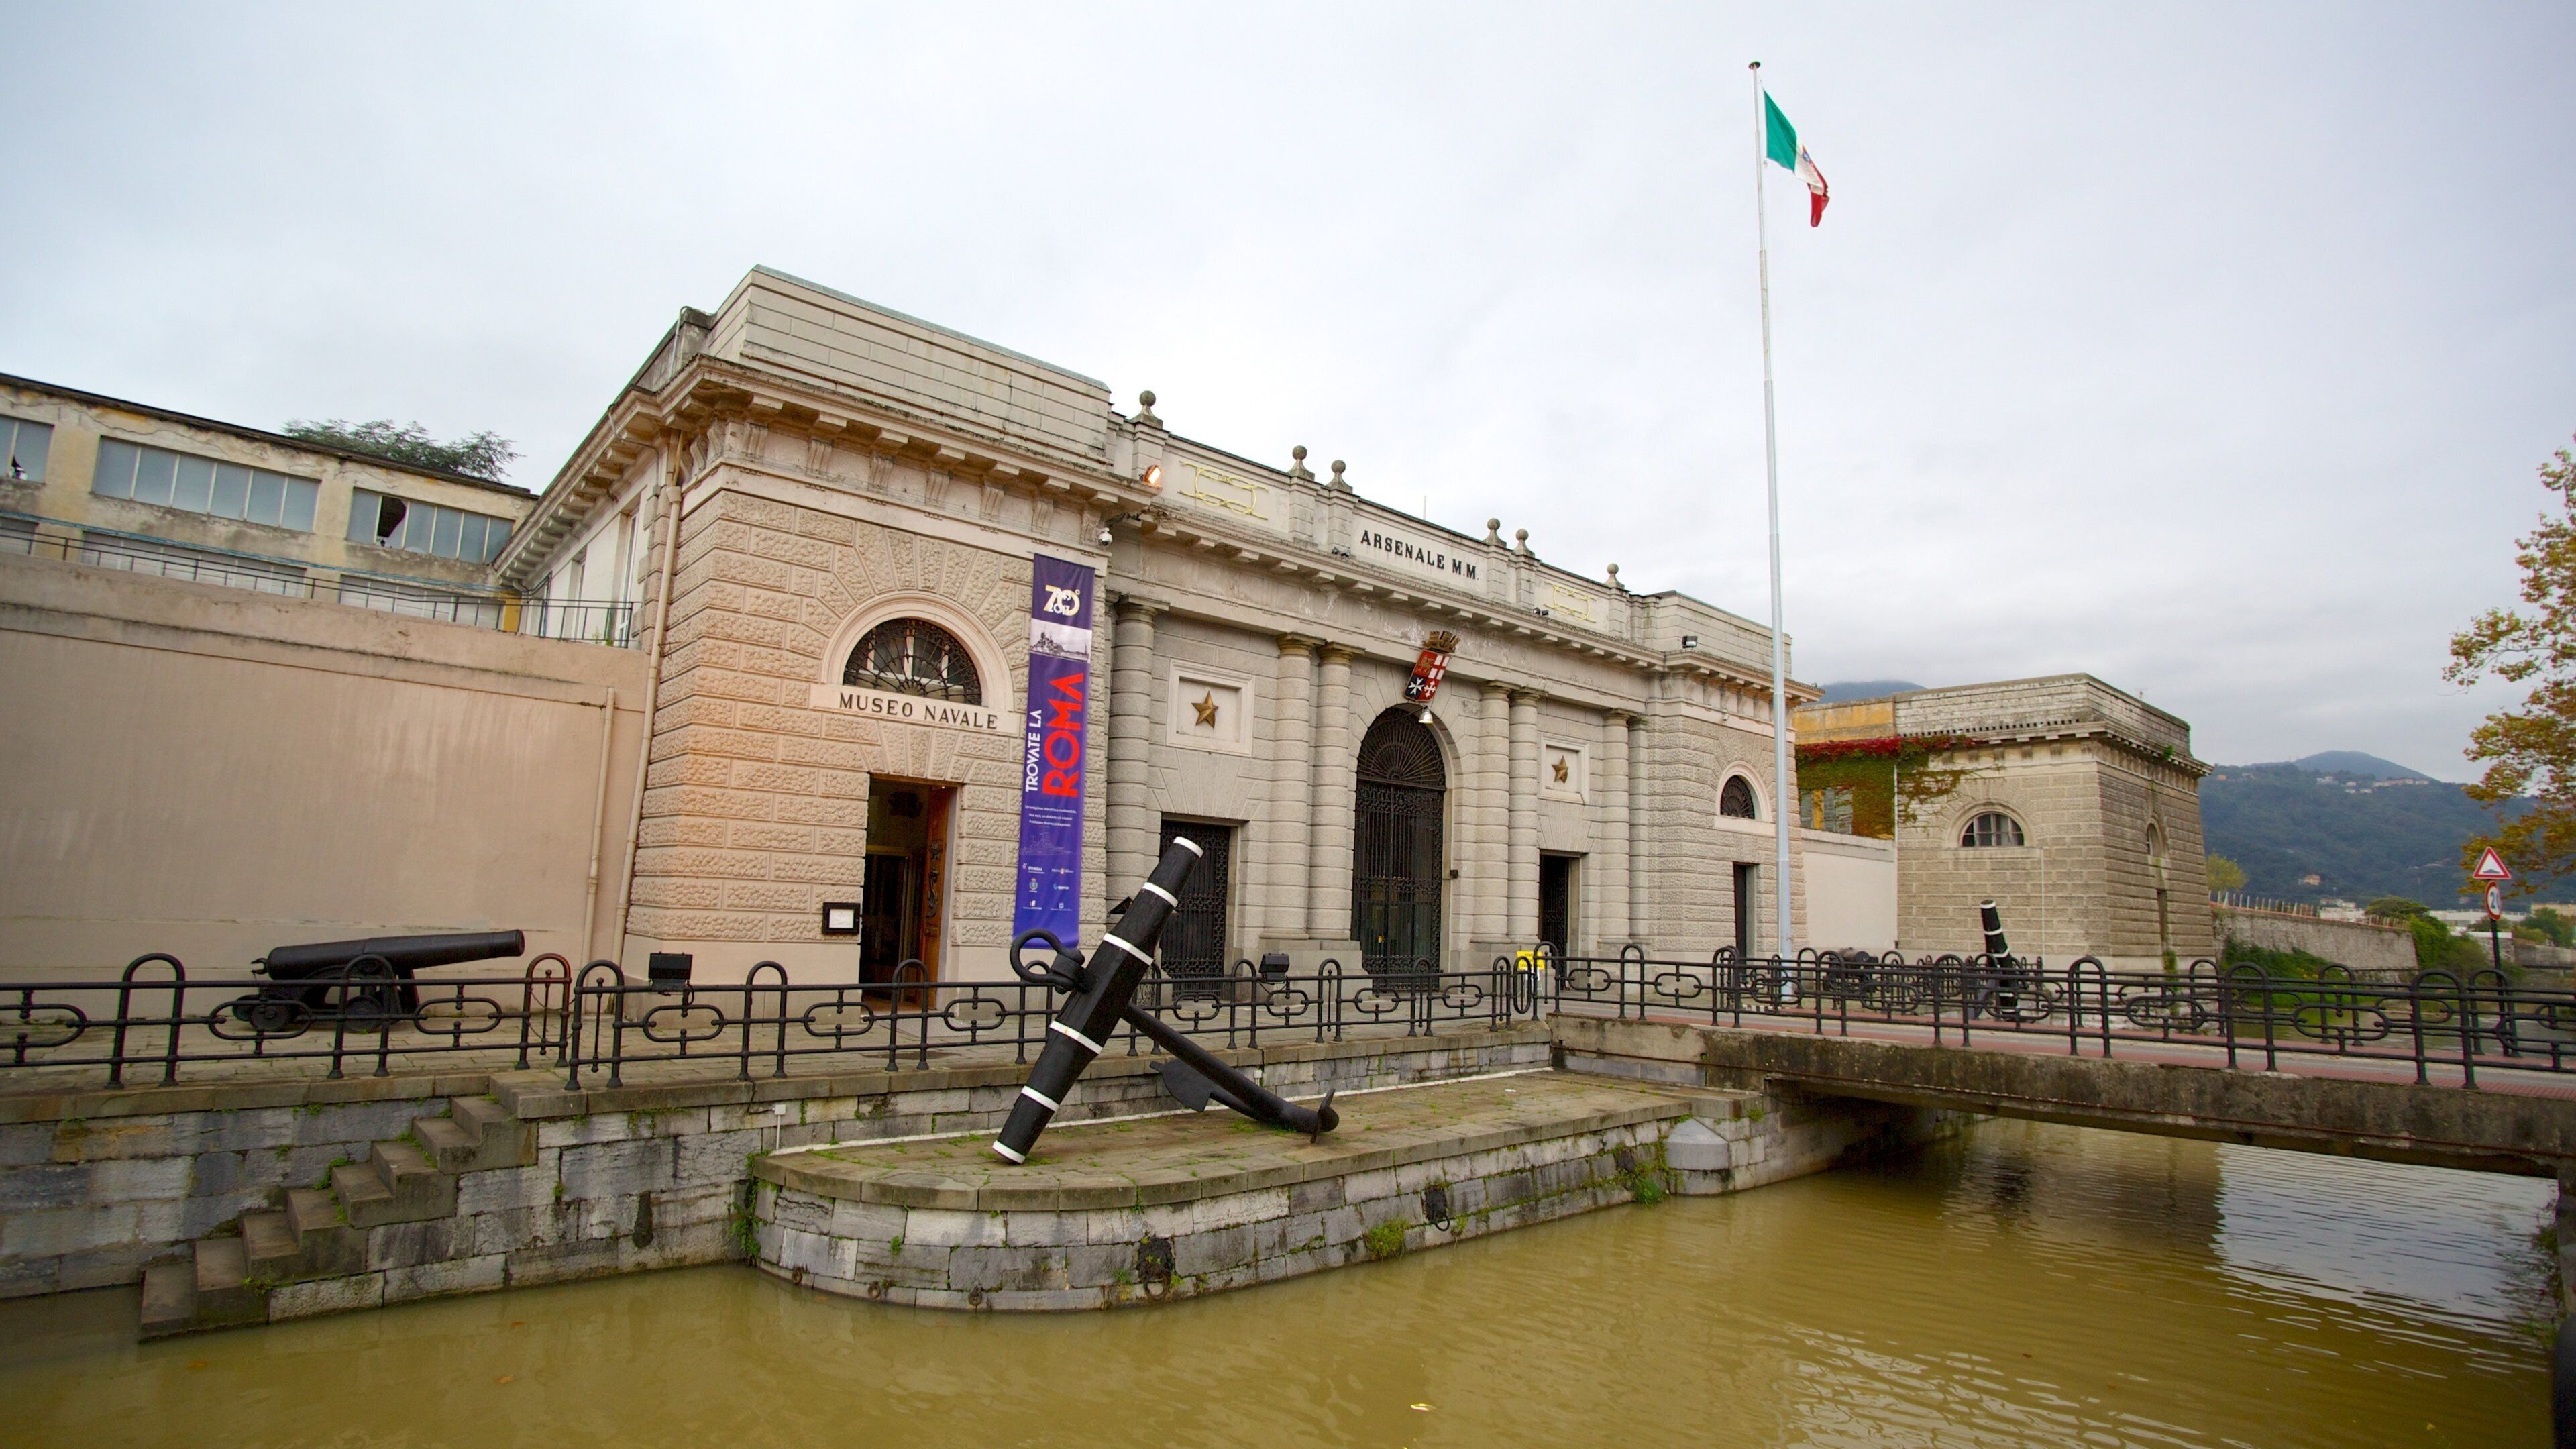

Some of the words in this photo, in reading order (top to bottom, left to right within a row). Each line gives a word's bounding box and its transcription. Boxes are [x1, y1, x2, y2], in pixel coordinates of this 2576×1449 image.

[1360, 529, 1444, 569] ARSENALE
[839, 692, 914, 718] MUSEO
[924, 704, 998, 730] NAVALE
[1029, 710, 1042, 729] LA
[1042, 672, 1084, 798] ROMA
[1025, 732, 1041, 792] TROVATE
